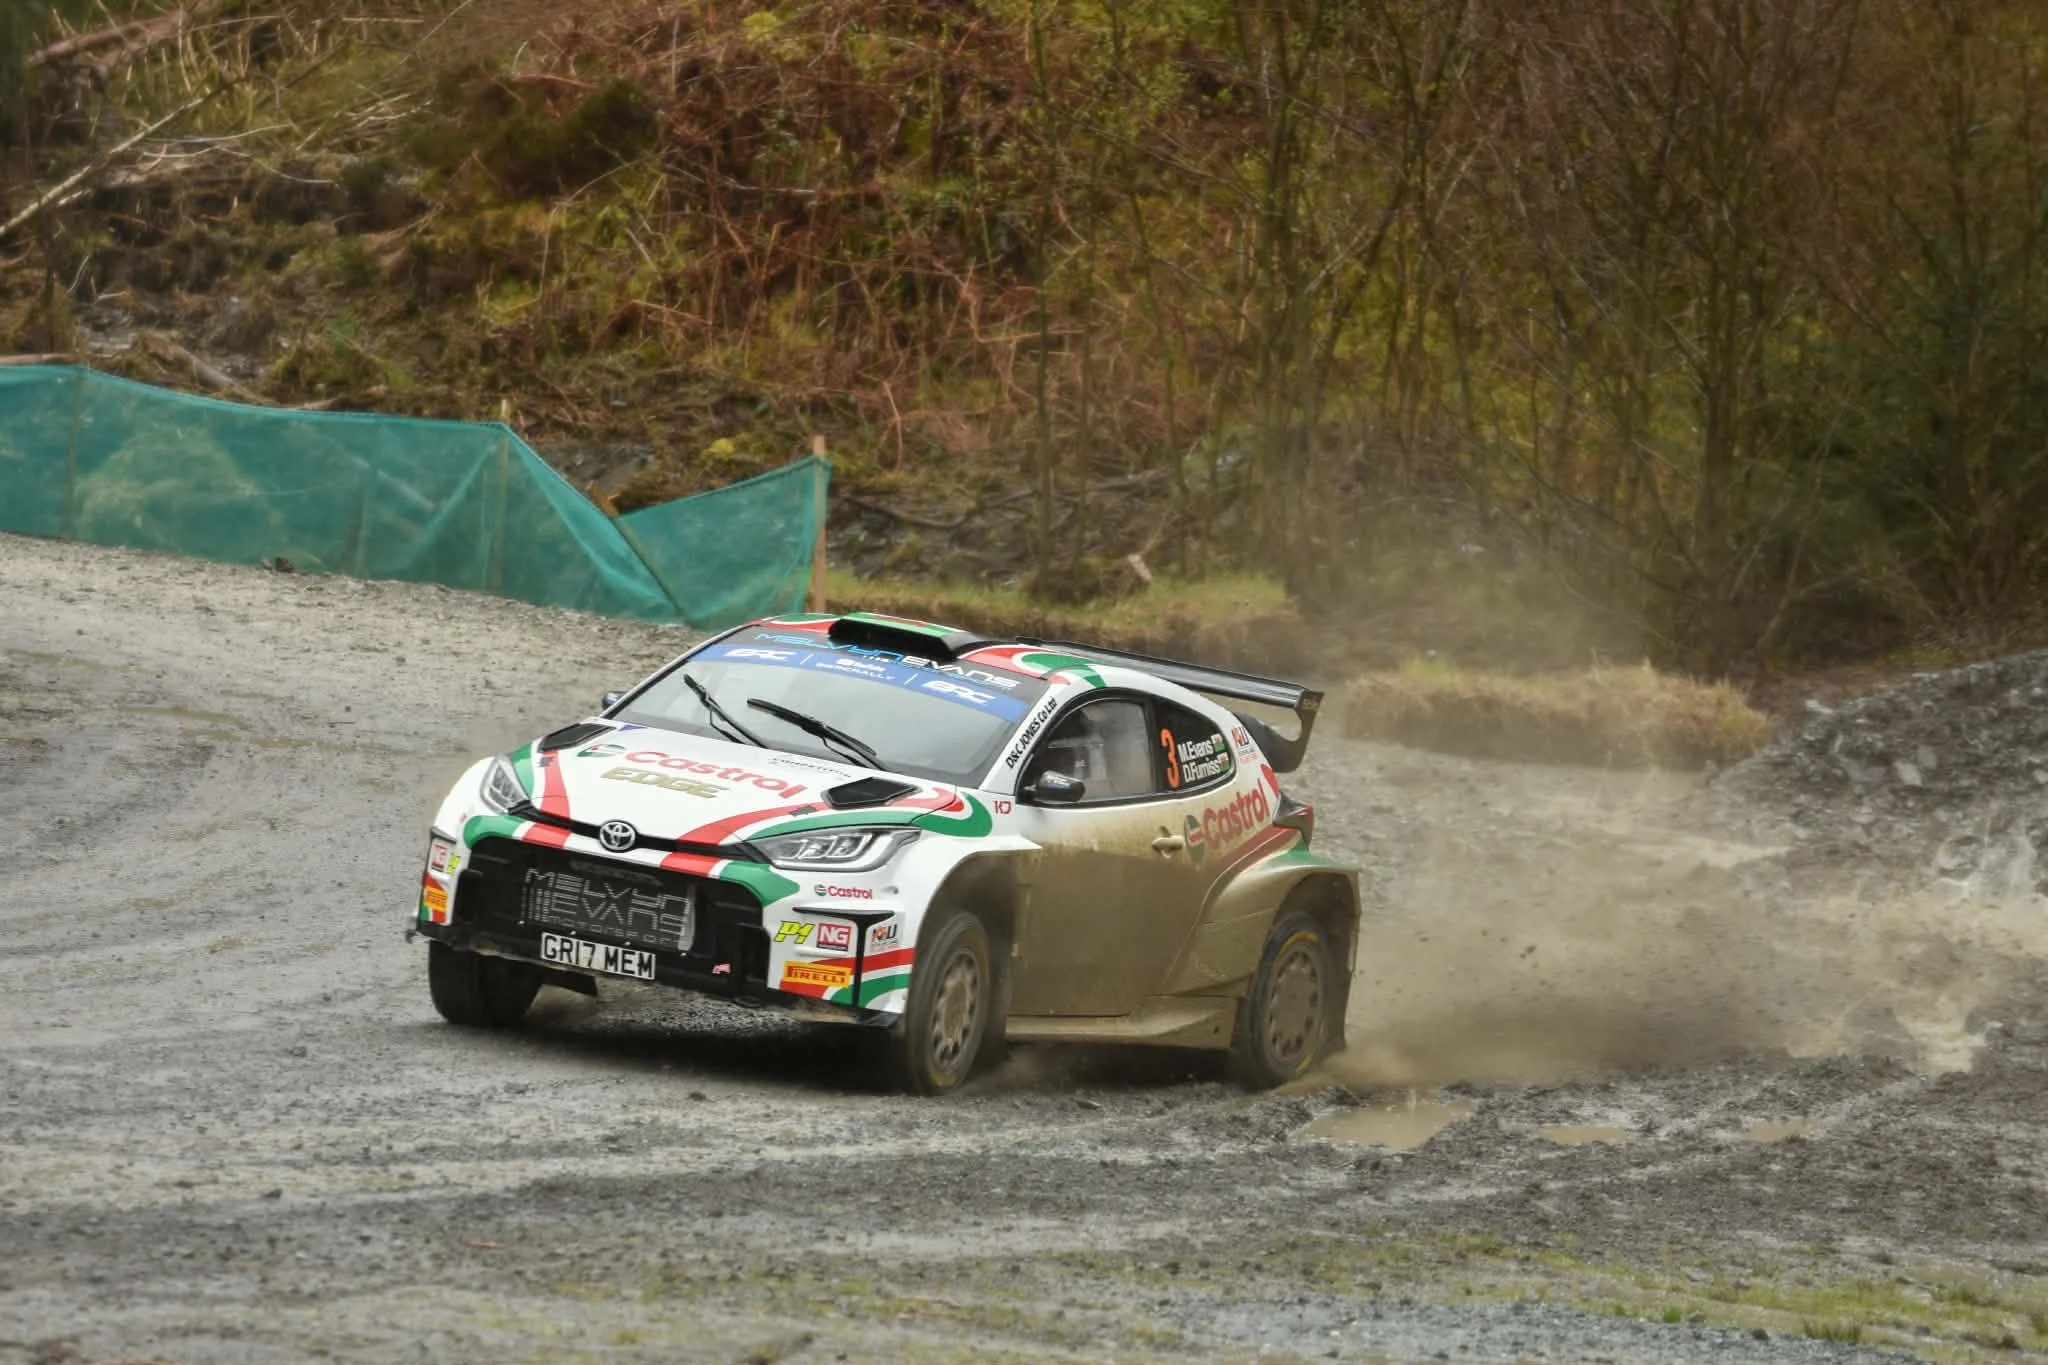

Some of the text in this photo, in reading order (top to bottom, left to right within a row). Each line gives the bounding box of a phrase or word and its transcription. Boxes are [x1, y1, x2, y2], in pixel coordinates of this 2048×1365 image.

[1018, 717, 1041, 749] JONES
[1160, 728, 1180, 789] 3
[1177, 740, 1214, 763] M.Evans
[600, 766, 730, 799] EDGE
[625, 751, 808, 799] Castrol
[1202, 778, 1270, 849] Castrol
[828, 886, 872, 899] Castrol
[819, 925, 850, 946] NG
[544, 934, 652, 978] GR17 MEM
[786, 965, 846, 984] PIRELLI
